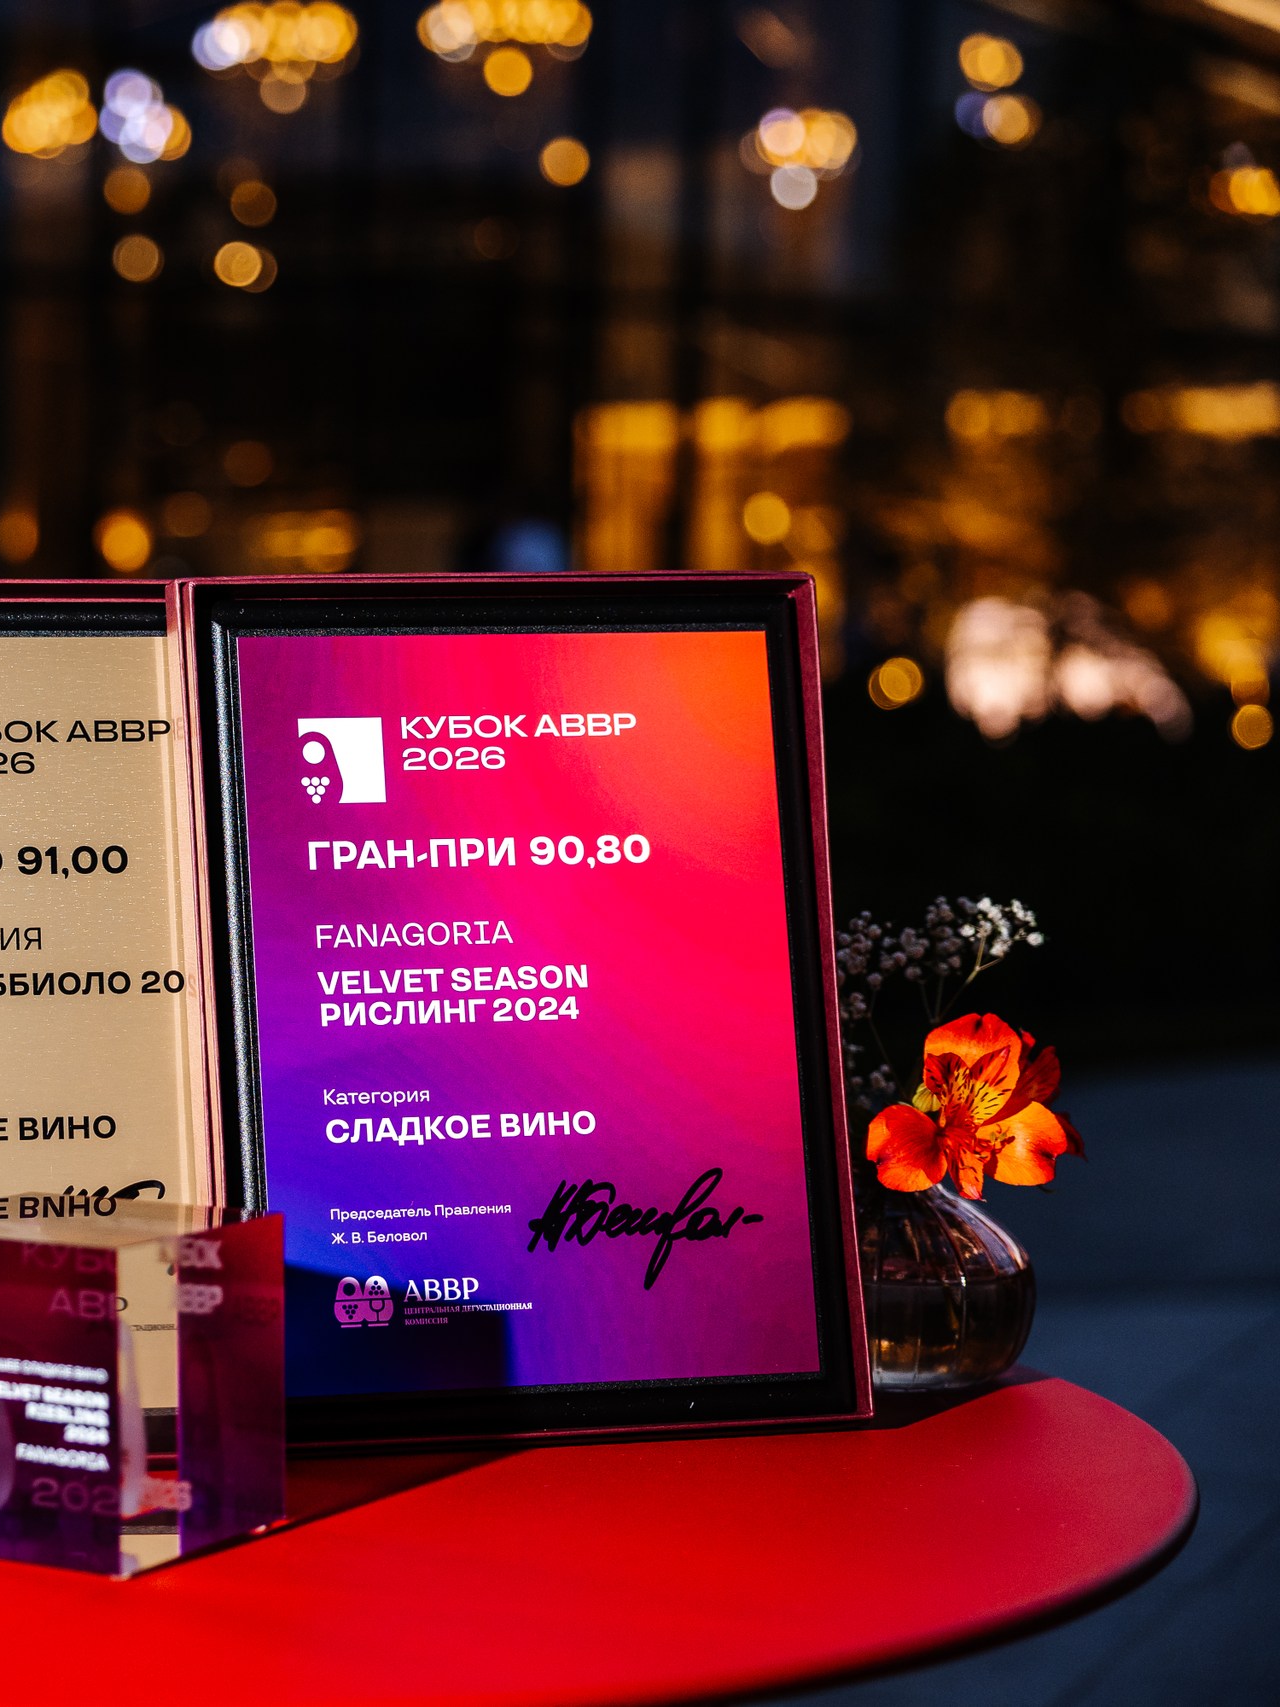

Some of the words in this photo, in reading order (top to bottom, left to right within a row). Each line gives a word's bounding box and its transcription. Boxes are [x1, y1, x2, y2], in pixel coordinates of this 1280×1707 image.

[66, 720, 171, 743] АВВР
[400, 714, 528, 740] КУБОК
[533, 713, 637, 737] АВВР
[402, 746, 506, 771] 2026
[17, 845, 129, 880] 91,00
[307, 837, 517, 871] ГРАН-ПРИ
[529, 833, 651, 869] 90,80
[315, 920, 514, 949] FANAGORIA
[317, 967, 445, 996] VELVET
[450, 964, 589, 992] SEASON
[321, 998, 487, 1028] РИСЛИНГ
[492, 995, 580, 1022] 2024
[322, 1087, 430, 1109] Категория
[19, 1114, 117, 1141] ВИНО
[325, 1113, 492, 1146] СЛАДКОЕ
[500, 1110, 597, 1138] ВИНО
[330, 1204, 432, 1223] Председатель
[434, 1202, 512, 1219] Правления
[331, 1232, 351, 1245] Ж.
[352, 1231, 365, 1244] В.
[367, 1229, 428, 1244] Беловол
[403, 1277, 479, 1303] АВВР
[404, 1304, 461, 1316] ЦЕНТРАЛЬНАЯ
[462, 1302, 533, 1313] ДЕГУСТАЦИОННАЯ
[404, 1317, 449, 1326] КОМИССИЯ
